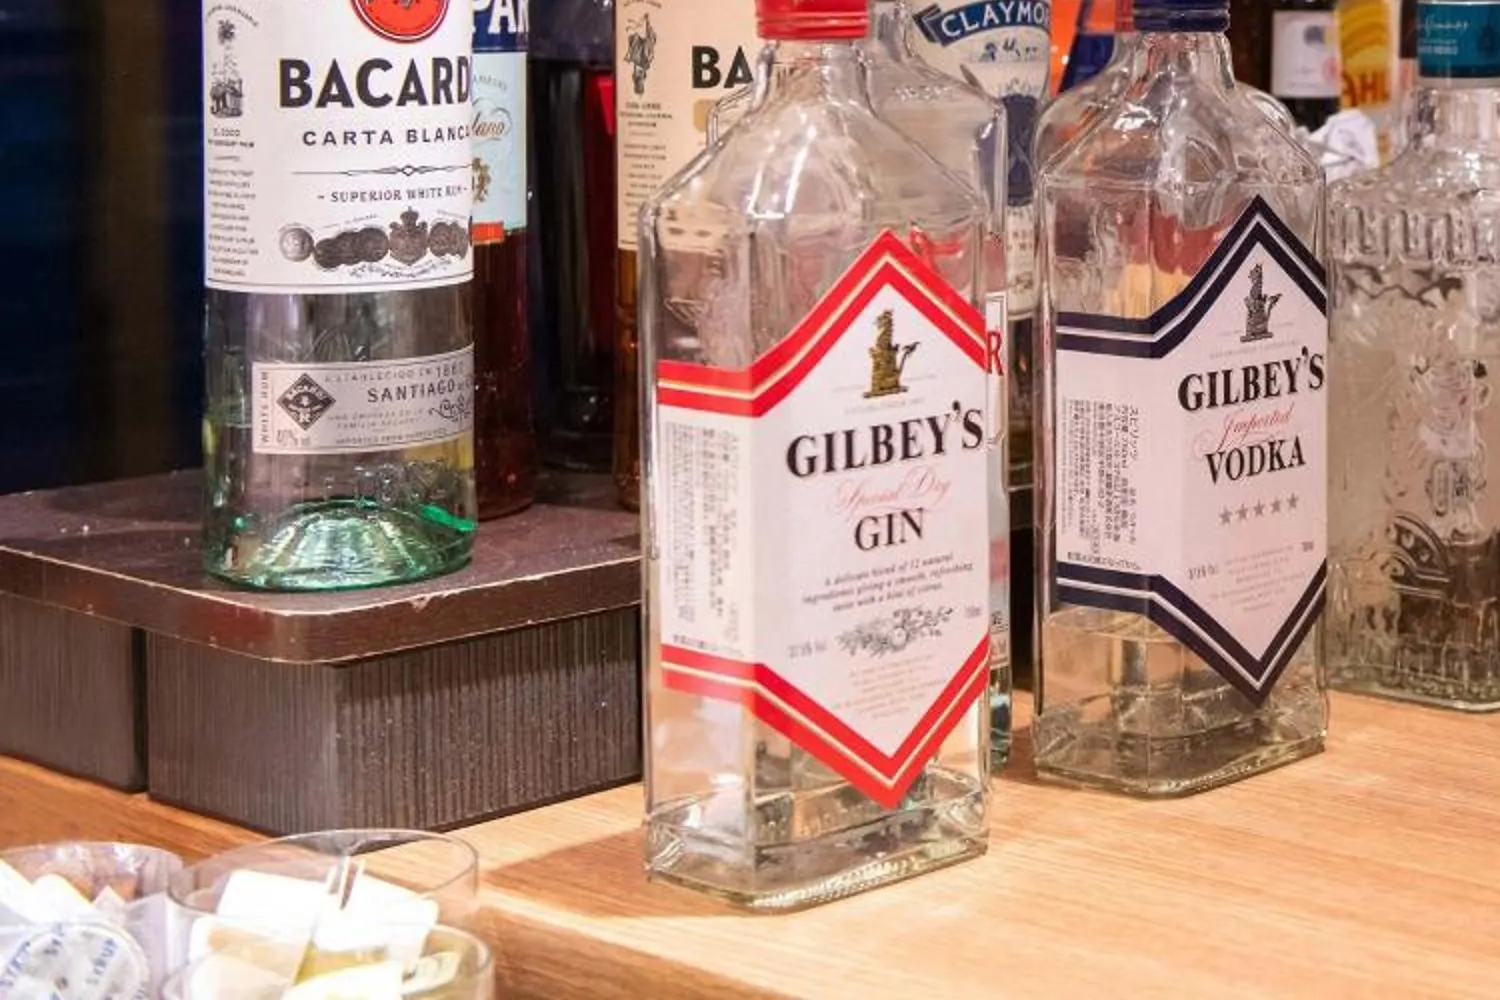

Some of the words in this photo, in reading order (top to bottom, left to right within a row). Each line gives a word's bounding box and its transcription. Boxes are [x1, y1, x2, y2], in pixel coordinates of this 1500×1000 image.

[692, 46, 754, 89] BA
[302, 130, 394, 146] CARTA
[331, 189, 402, 202] SUPERIOR
[406, 187, 442, 199] WHITE
[367, 379, 456, 403] SANTIAGO
[1178, 345, 1325, 412] GILBEY'S
[786, 400, 984, 479] GILBEY'S
[1206, 435, 1306, 485] VODKA
[854, 507, 925, 552] GIN
